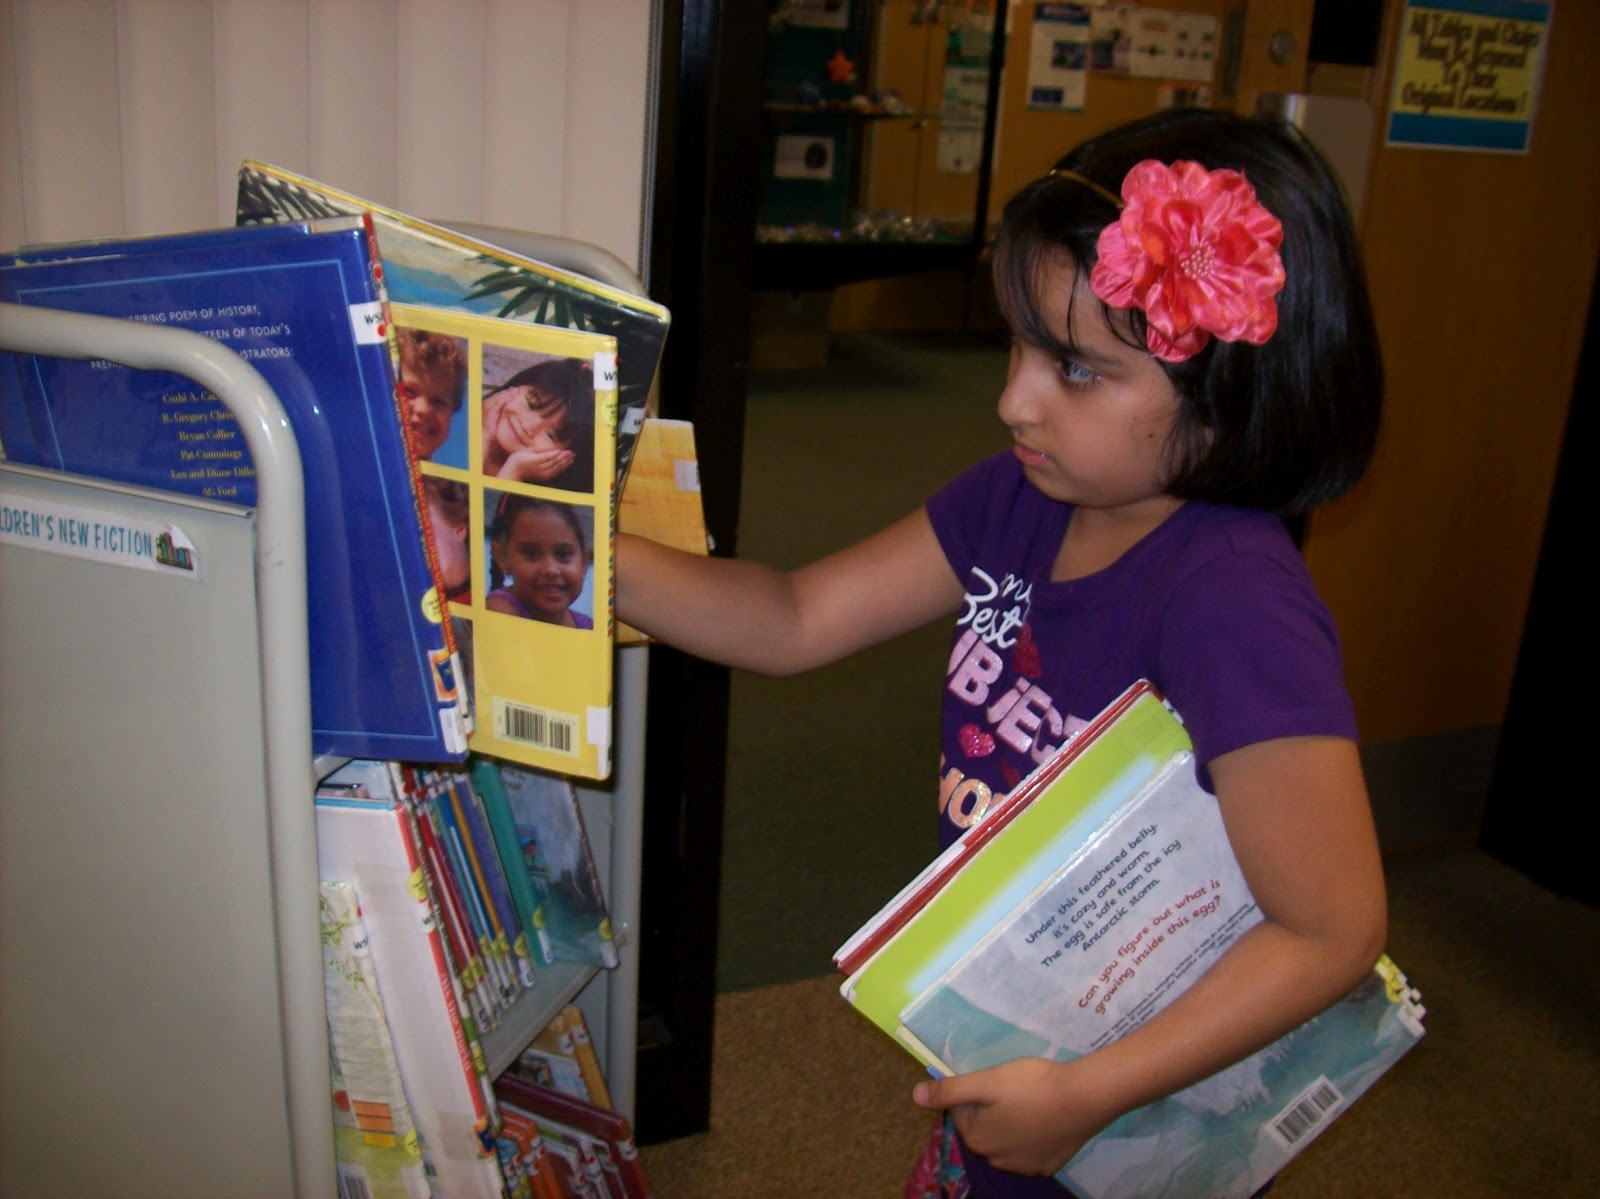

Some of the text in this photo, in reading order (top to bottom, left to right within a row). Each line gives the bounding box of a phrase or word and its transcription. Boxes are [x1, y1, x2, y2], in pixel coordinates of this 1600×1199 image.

[169, 309, 198, 320] POEM
[200, 307, 214, 319] OF
[232, 326, 246, 338] OF
[249, 322, 291, 336] TODAY'S
[178, 429, 235, 443] Bryan Collier
[180, 450, 195, 460] Pat
[189, 468, 204, 478] and
[206, 467, 231, 478] Diane
[58, 517, 90, 548] NEW
[94, 523, 153, 558] FICTION
[1025, 915, 1056, 944] Under
[1057, 895, 1078, 915] this
[1078, 849, 1128, 895] feathered
[1041, 839, 1183, 968] The egg is safe from the icy
[1052, 849, 1151, 939] it's cozy and warm.
[1082, 877, 1161, 952] Antarctic storm.
[1078, 878, 1222, 1009] Can you figure out what is
[1094, 966, 1136, 1015] growing
[1131, 934, 1166, 967] inside
[1166, 916, 1191, 936] this
[1192, 894, 1222, 918] egg?
